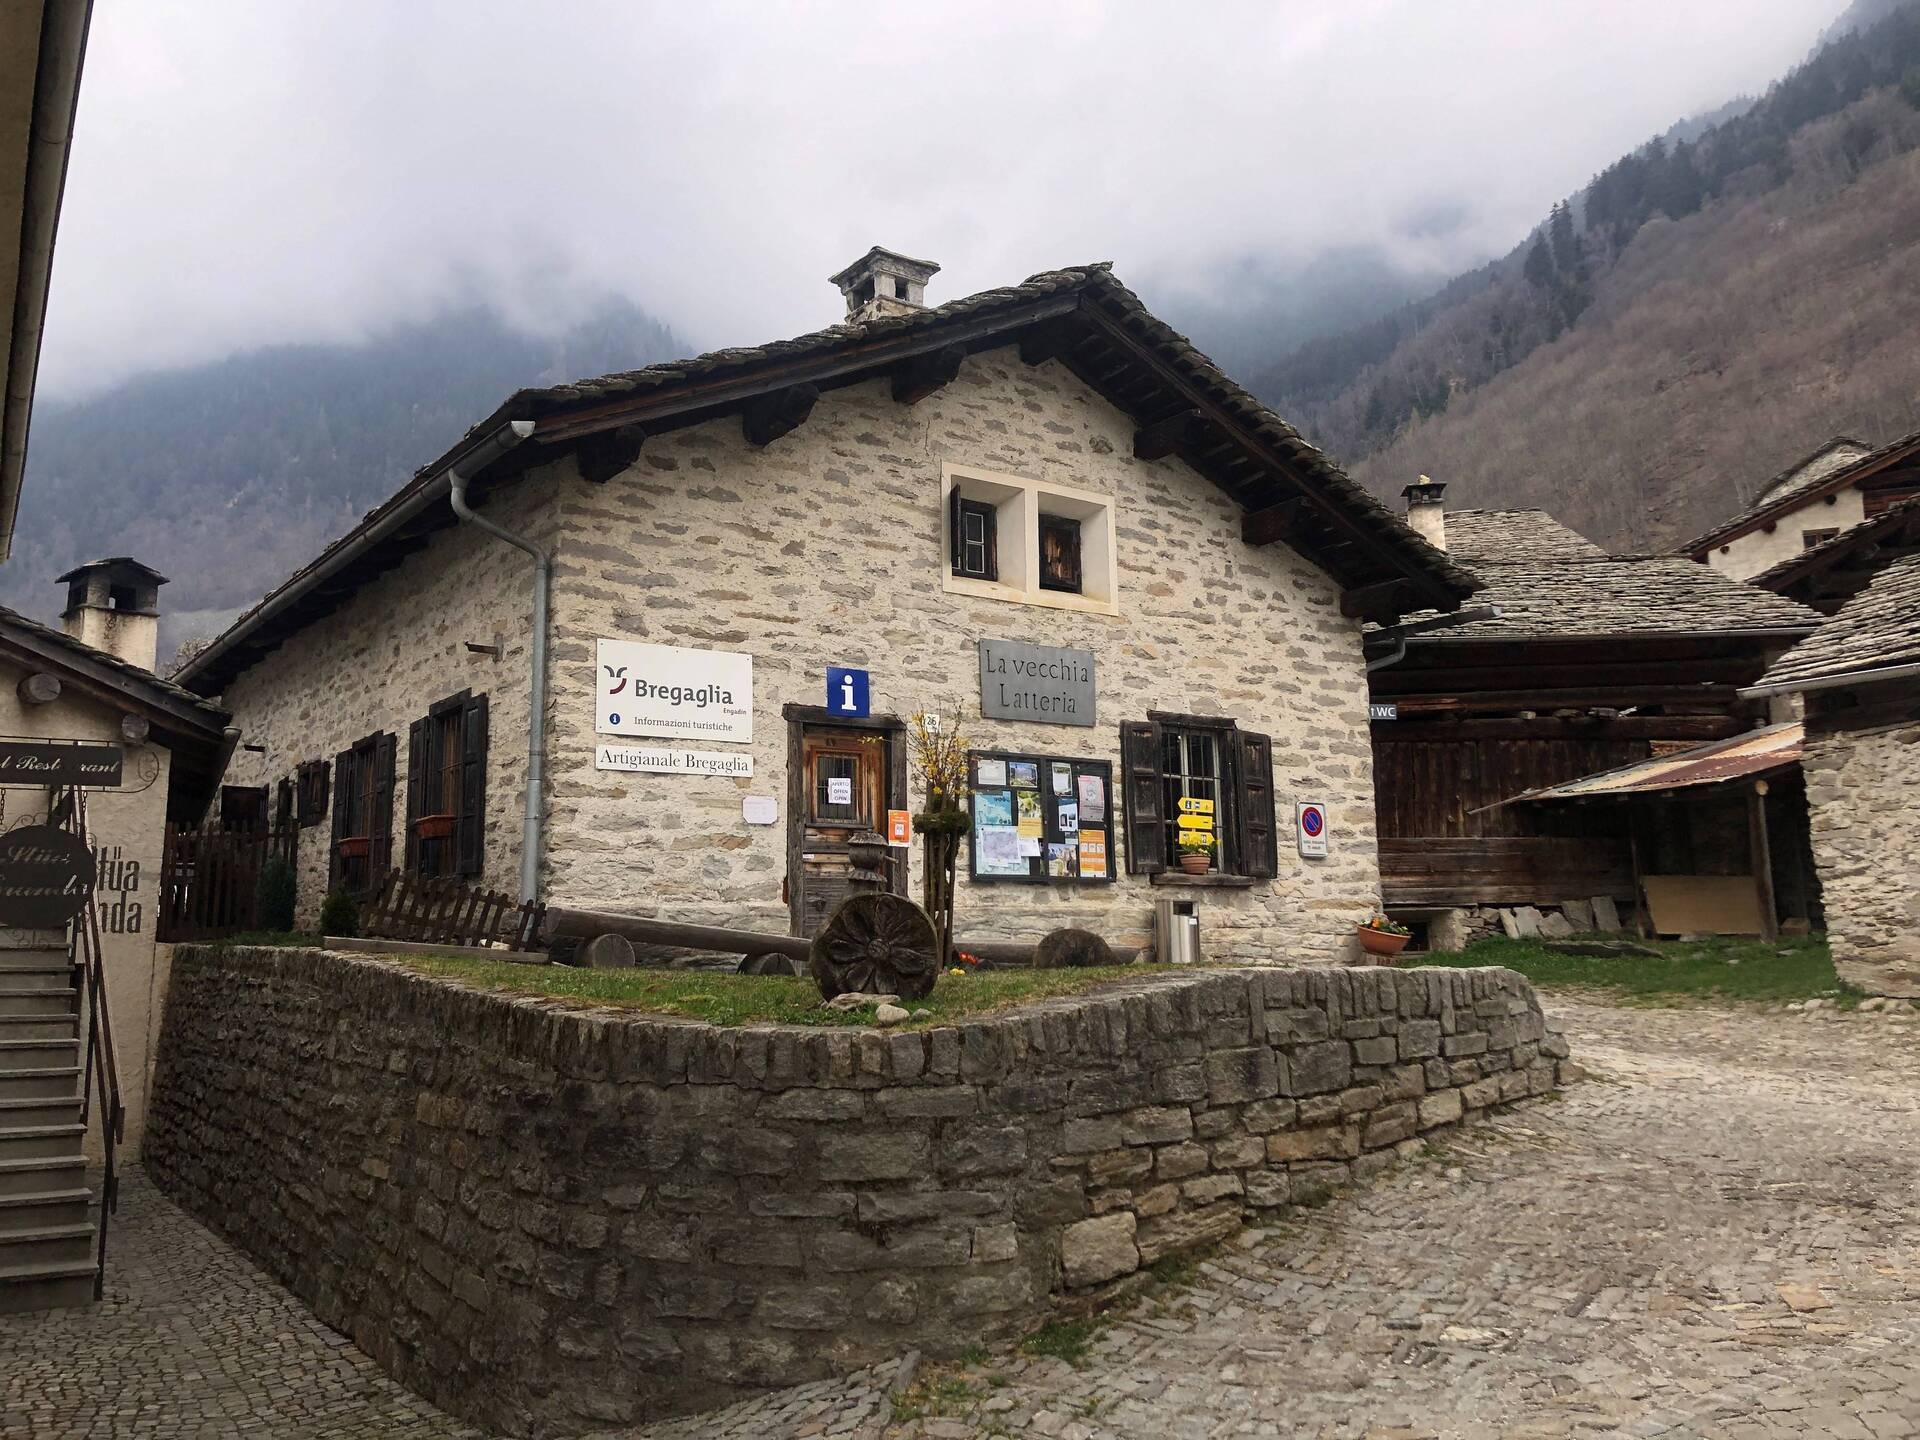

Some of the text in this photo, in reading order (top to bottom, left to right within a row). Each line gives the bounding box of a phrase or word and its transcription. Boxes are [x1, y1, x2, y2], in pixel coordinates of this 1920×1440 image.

[986, 650, 1089, 683] La vecchia
[635, 679, 734, 708] Bregaglia
[841, 674, 857, 711] i
[999, 683, 1077, 714] Latteria
[634, 716, 691, 729] Informazioni
[693, 721, 733, 732] turistiche
[723, 707, 747, 716] Engadin
[1376, 706, 1396, 717] WC
[600, 749, 749, 774] Artigianale Bregaglia
[98, 846, 140, 892] tüa
